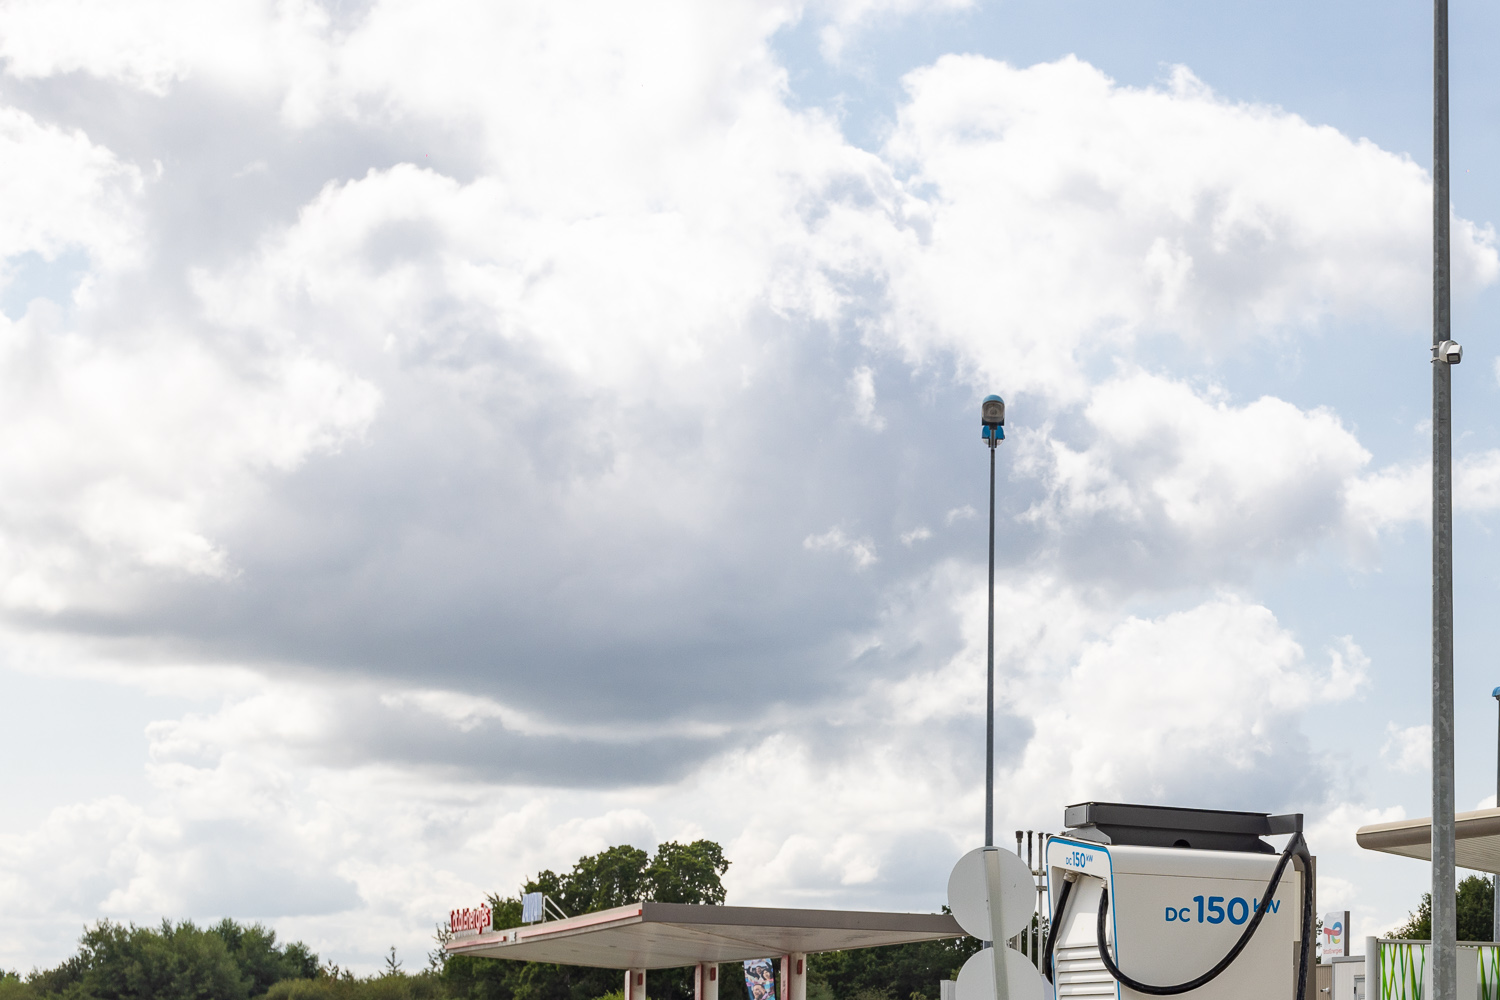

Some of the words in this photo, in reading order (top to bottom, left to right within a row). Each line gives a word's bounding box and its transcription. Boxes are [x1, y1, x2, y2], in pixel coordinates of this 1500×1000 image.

[1066, 856, 1072, 866] DC
[1072, 851, 1086, 868] 150
[1165, 907, 1190, 922] DC
[1193, 895, 1249, 925] 150
